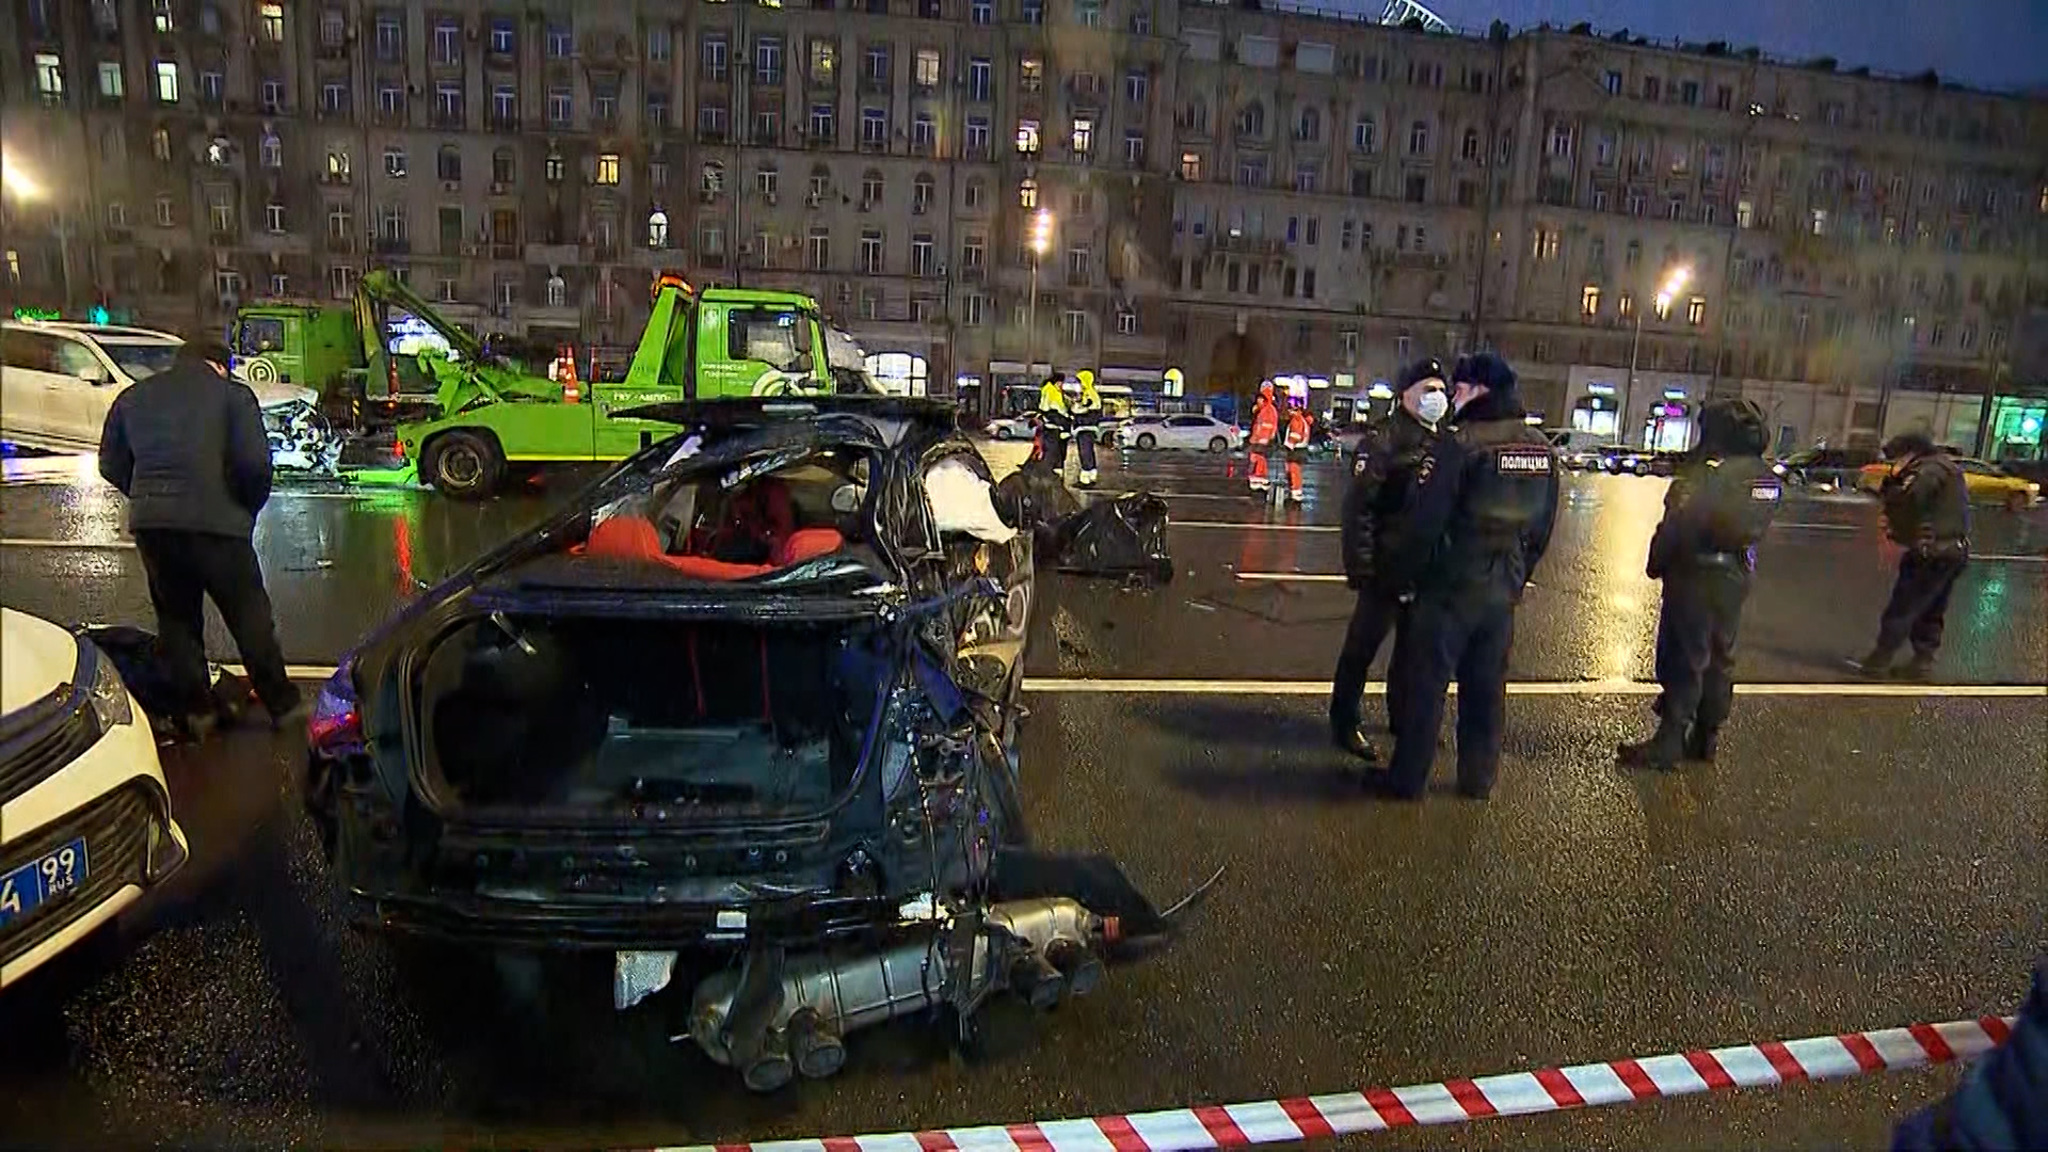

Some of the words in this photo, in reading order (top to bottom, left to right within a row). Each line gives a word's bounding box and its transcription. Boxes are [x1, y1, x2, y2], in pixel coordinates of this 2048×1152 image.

[1501, 455, 1549, 472] ПОЛИЦИЯ
[41, 848, 75, 883] 99
[48, 873, 74, 895] RUS
